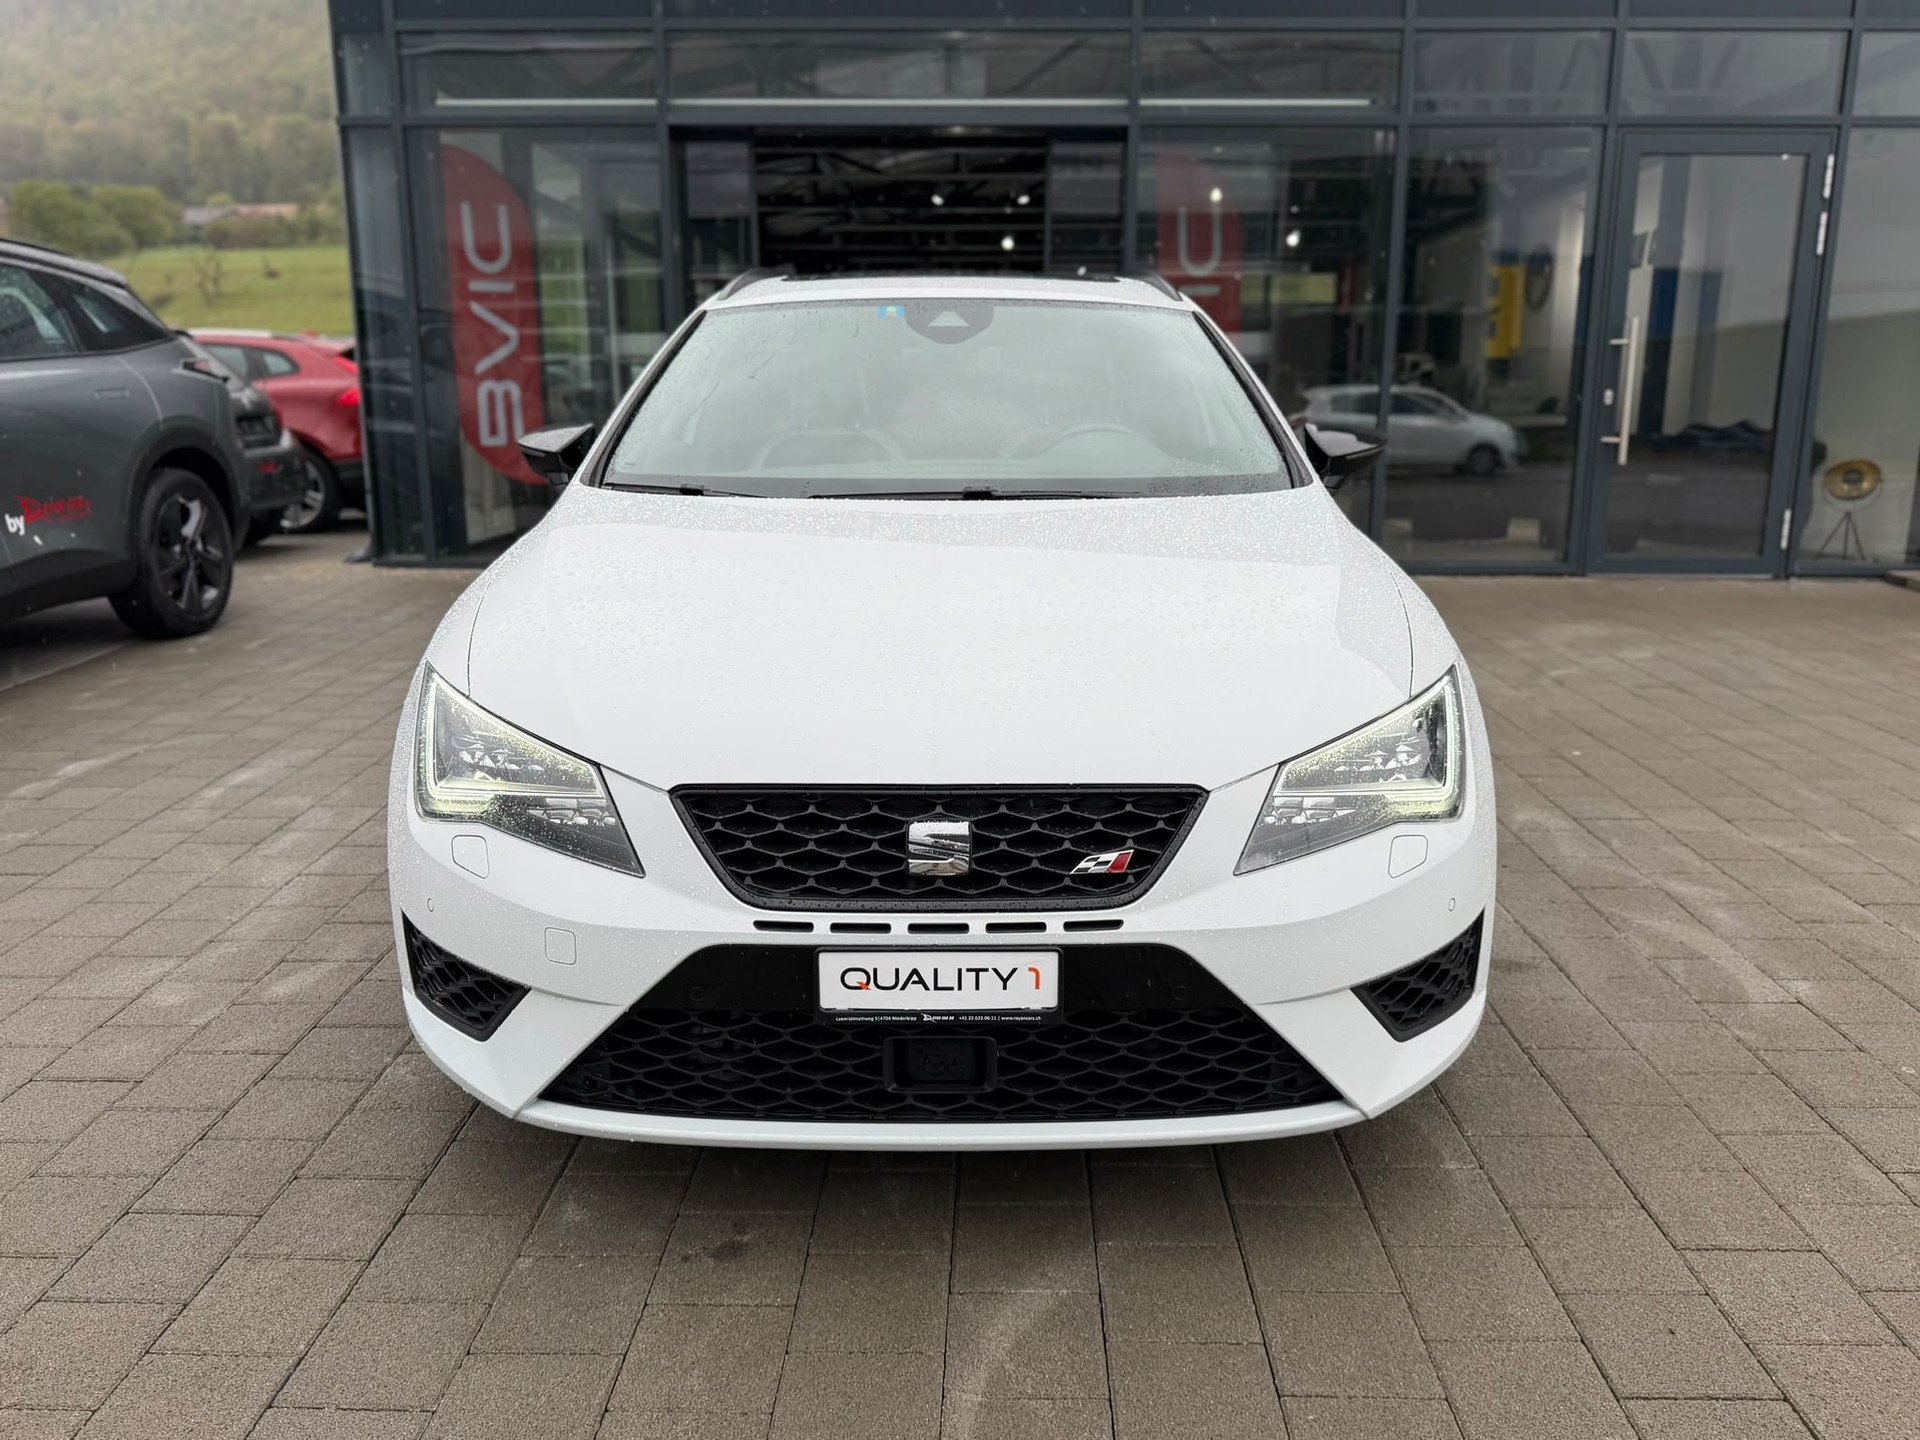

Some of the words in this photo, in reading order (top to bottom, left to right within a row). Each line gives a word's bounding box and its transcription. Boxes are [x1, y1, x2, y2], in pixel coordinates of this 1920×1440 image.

[4, 513, 26, 536] by
[840, 967, 1019, 991] QUALITY
[1028, 967, 1041, 990] 1
